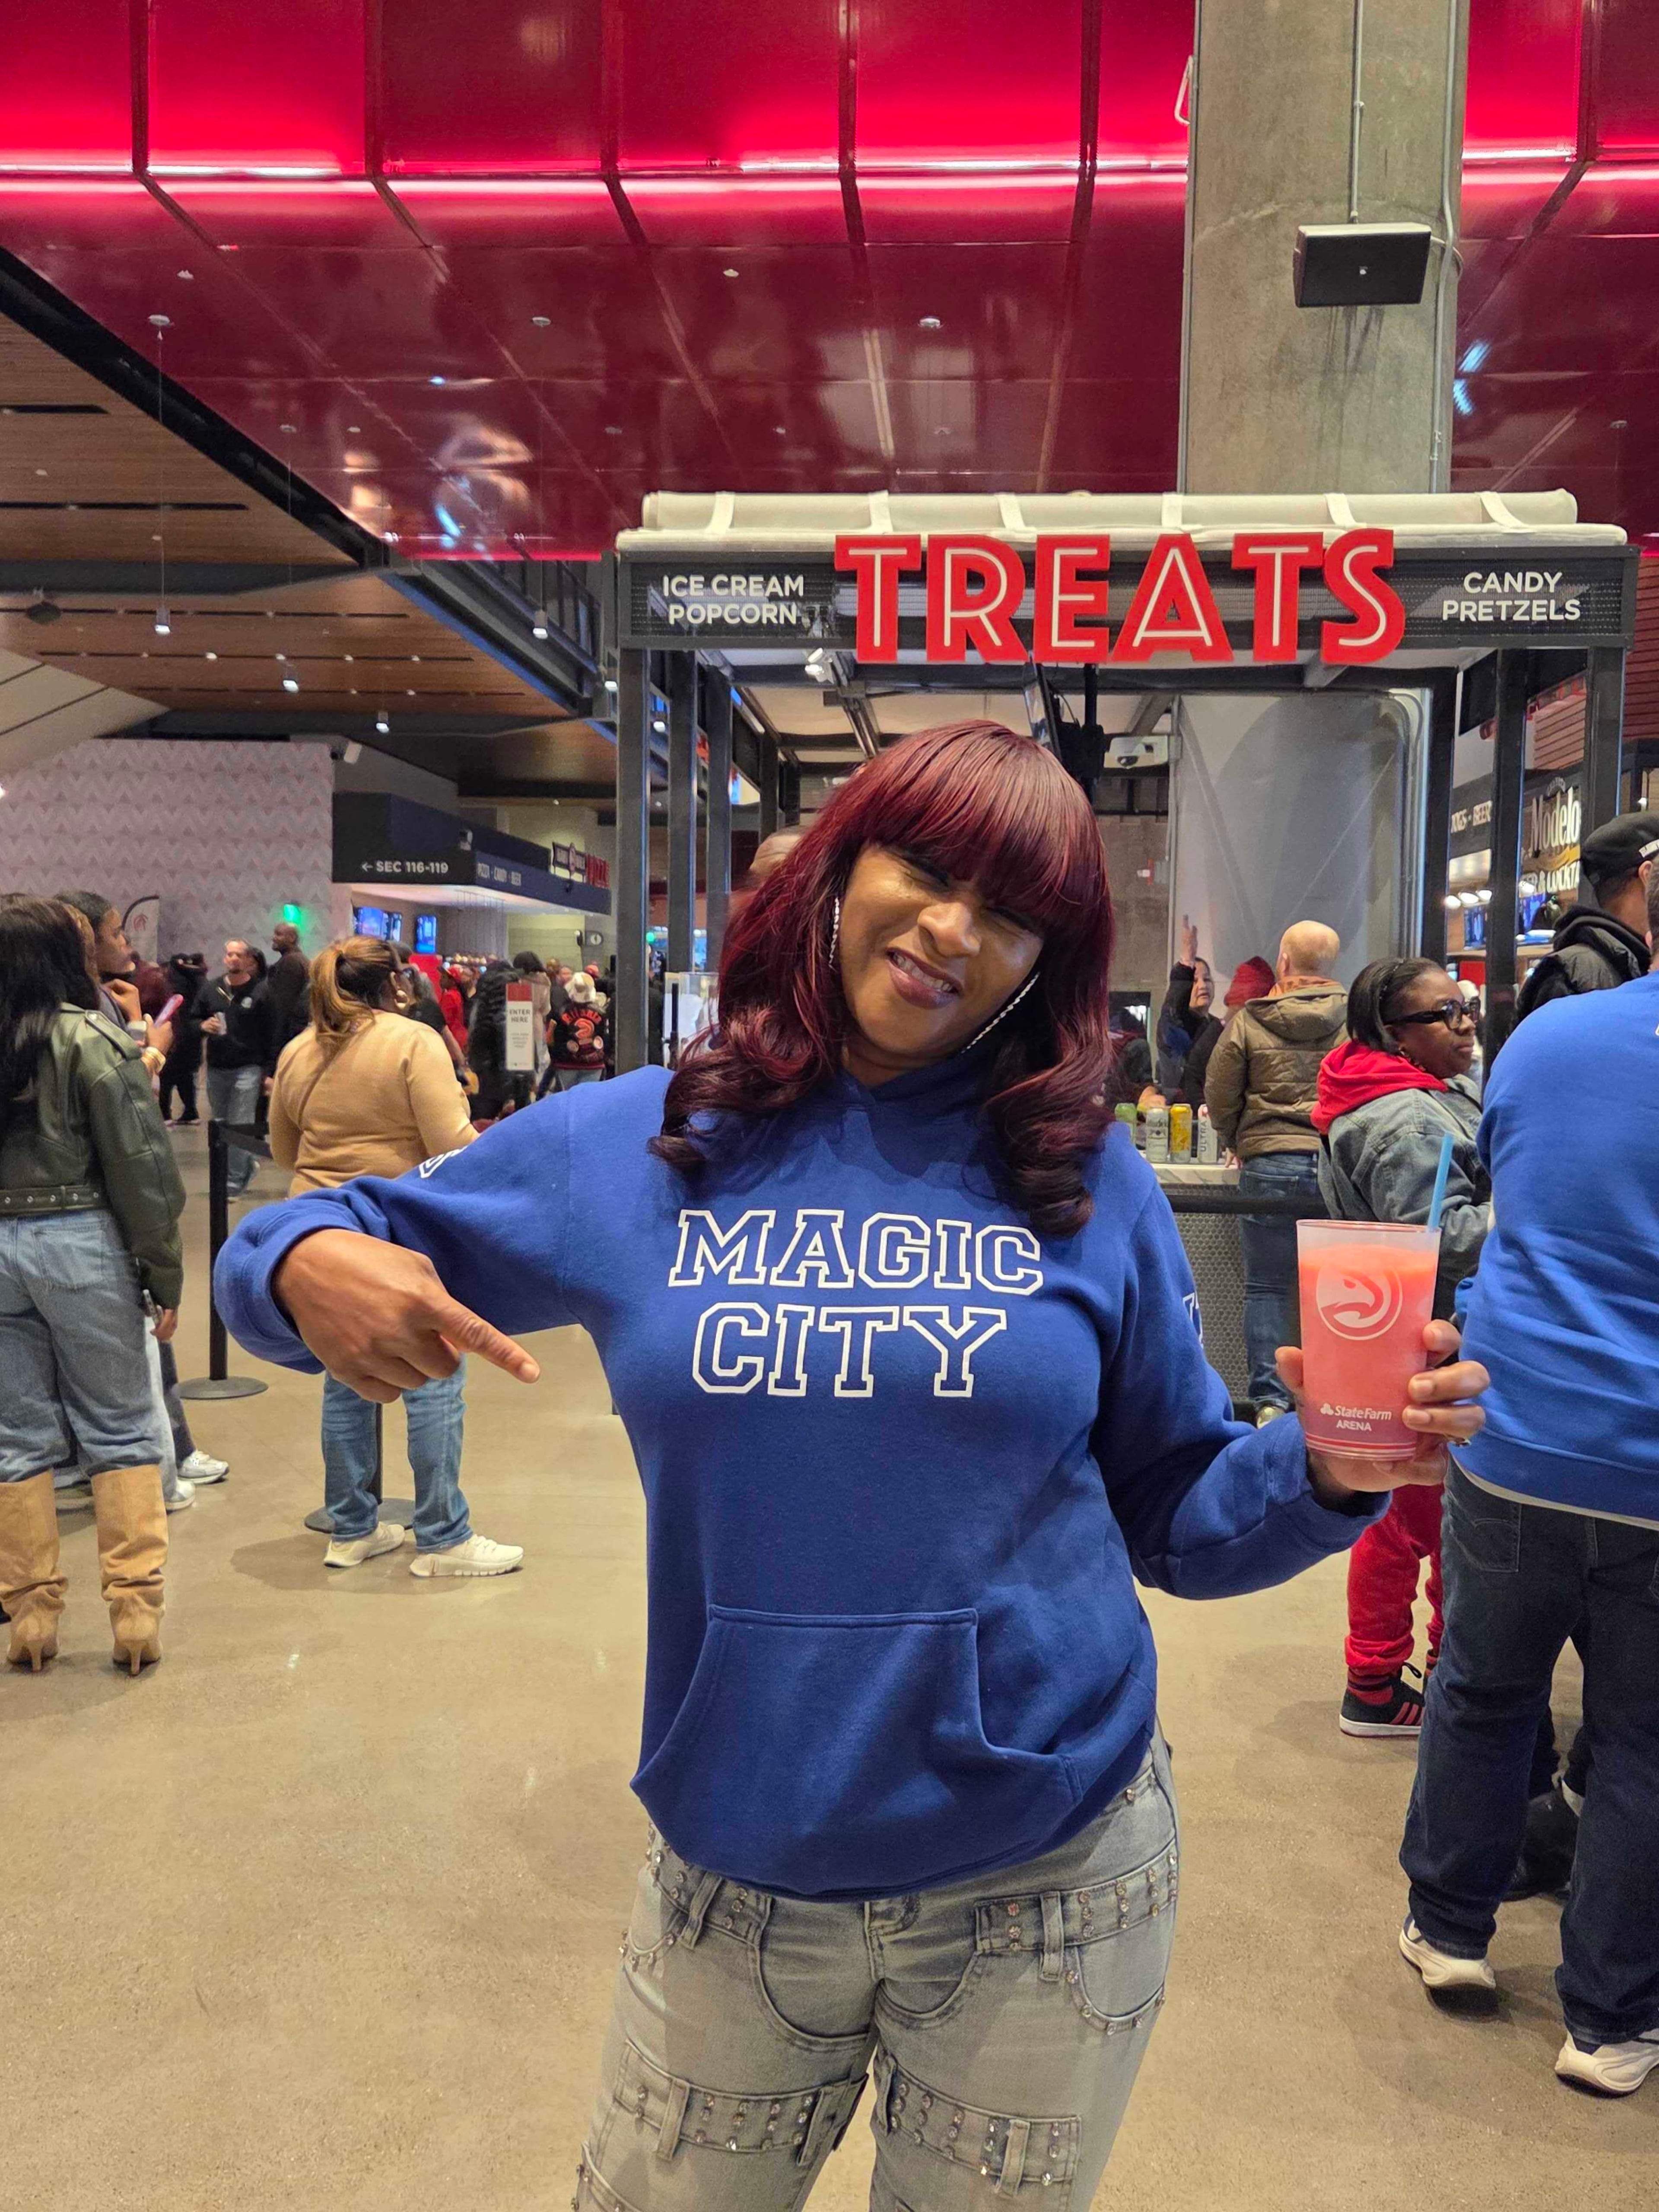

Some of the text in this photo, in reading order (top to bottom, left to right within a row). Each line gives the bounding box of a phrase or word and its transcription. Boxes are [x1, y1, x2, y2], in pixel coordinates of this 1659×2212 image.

[663, 574, 804, 597] ICE CREAM
[1463, 571, 1562, 594] CANDY
[834, 530, 1406, 664] TREATS
[669, 602, 797, 624] POPCORN
[1442, 599, 1580, 622] PRETZELS
[1473, 801, 1493, 826] BEER
[1529, 786, 1581, 857] Modelo
[376, 860, 449, 874] SEC 116-119
[1199, 1119, 1208, 1152] ULTRA
[667, 1209, 1044, 1296] MAGIC
[692, 1302, 1007, 1398] CITY
[1335, 1419, 1372, 1432] ARENA
